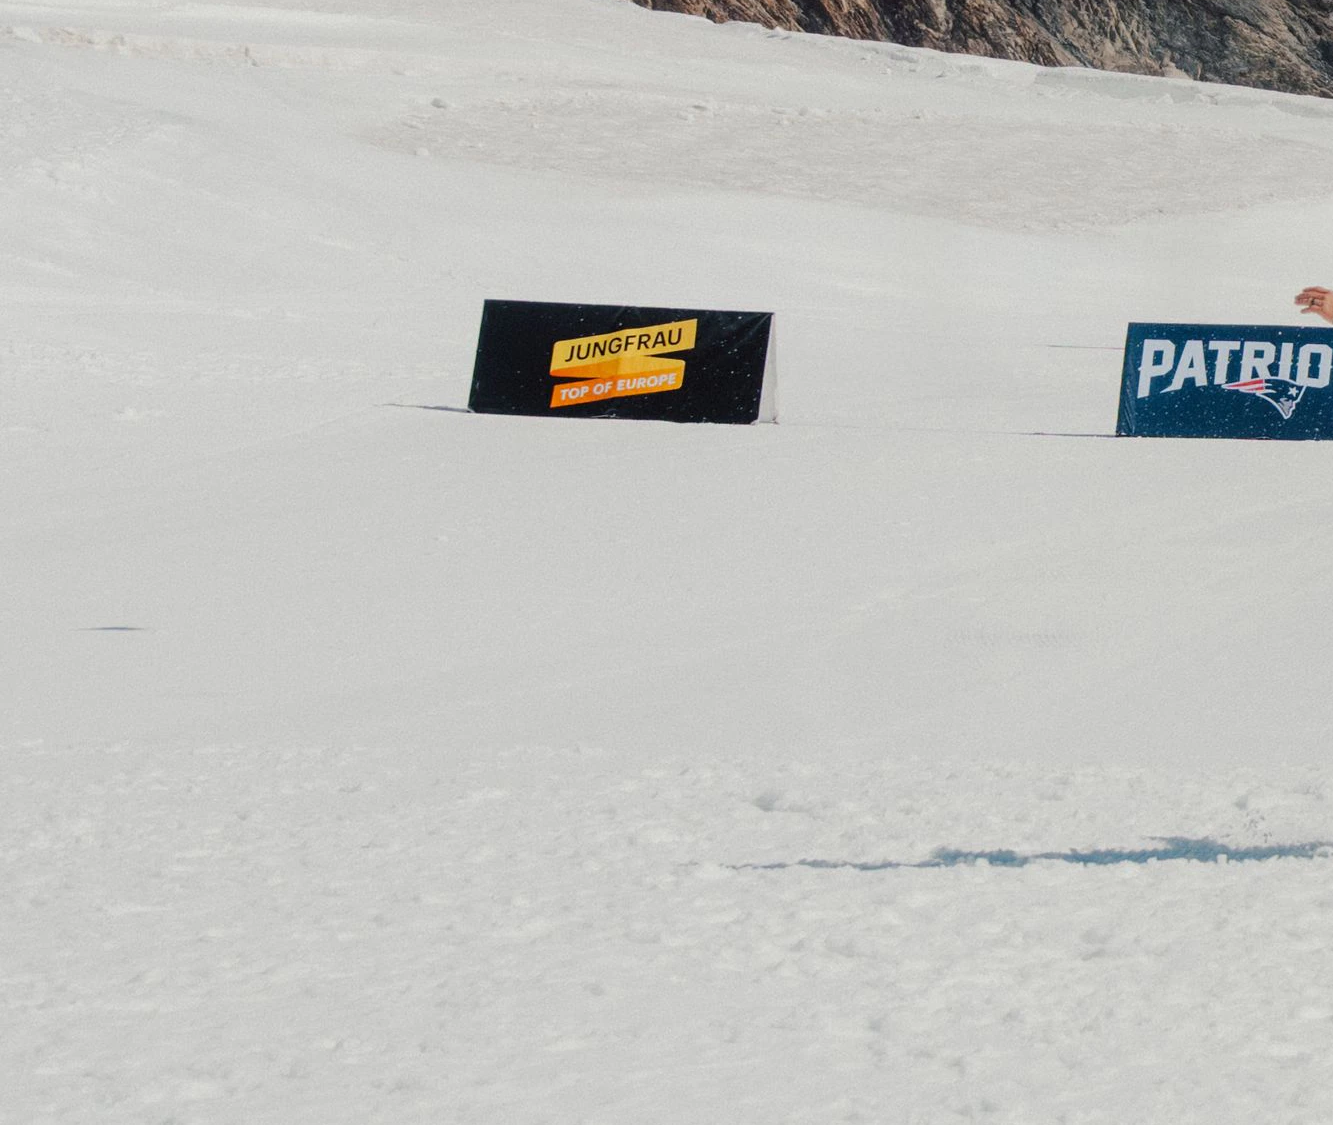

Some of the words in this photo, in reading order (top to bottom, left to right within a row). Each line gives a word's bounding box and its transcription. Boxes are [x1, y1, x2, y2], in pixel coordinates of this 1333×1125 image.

[564, 327, 683, 363] JUNGFRAU
[559, 385, 589, 401] TOP
[593, 380, 613, 396] OF
[616, 372, 677, 392] EUROPE
